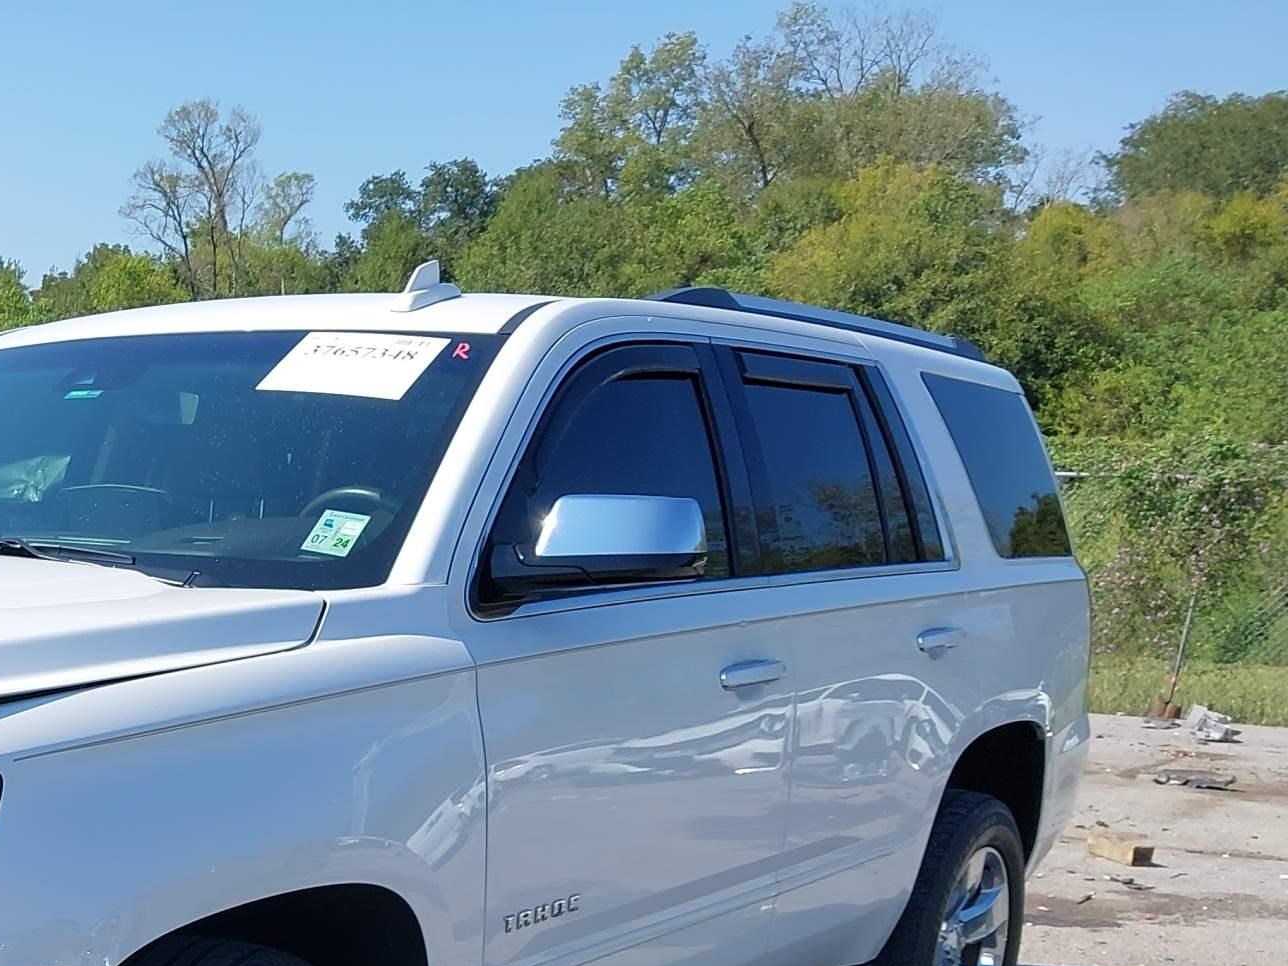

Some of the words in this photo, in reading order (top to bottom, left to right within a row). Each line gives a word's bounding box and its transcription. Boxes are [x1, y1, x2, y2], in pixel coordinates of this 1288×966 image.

[304, 344, 420, 361] 37657348
[451, 342, 471, 360] R
[311, 533, 328, 545] 07
[333, 537, 351, 549] 24
[503, 892, 582, 935] TAHOE
